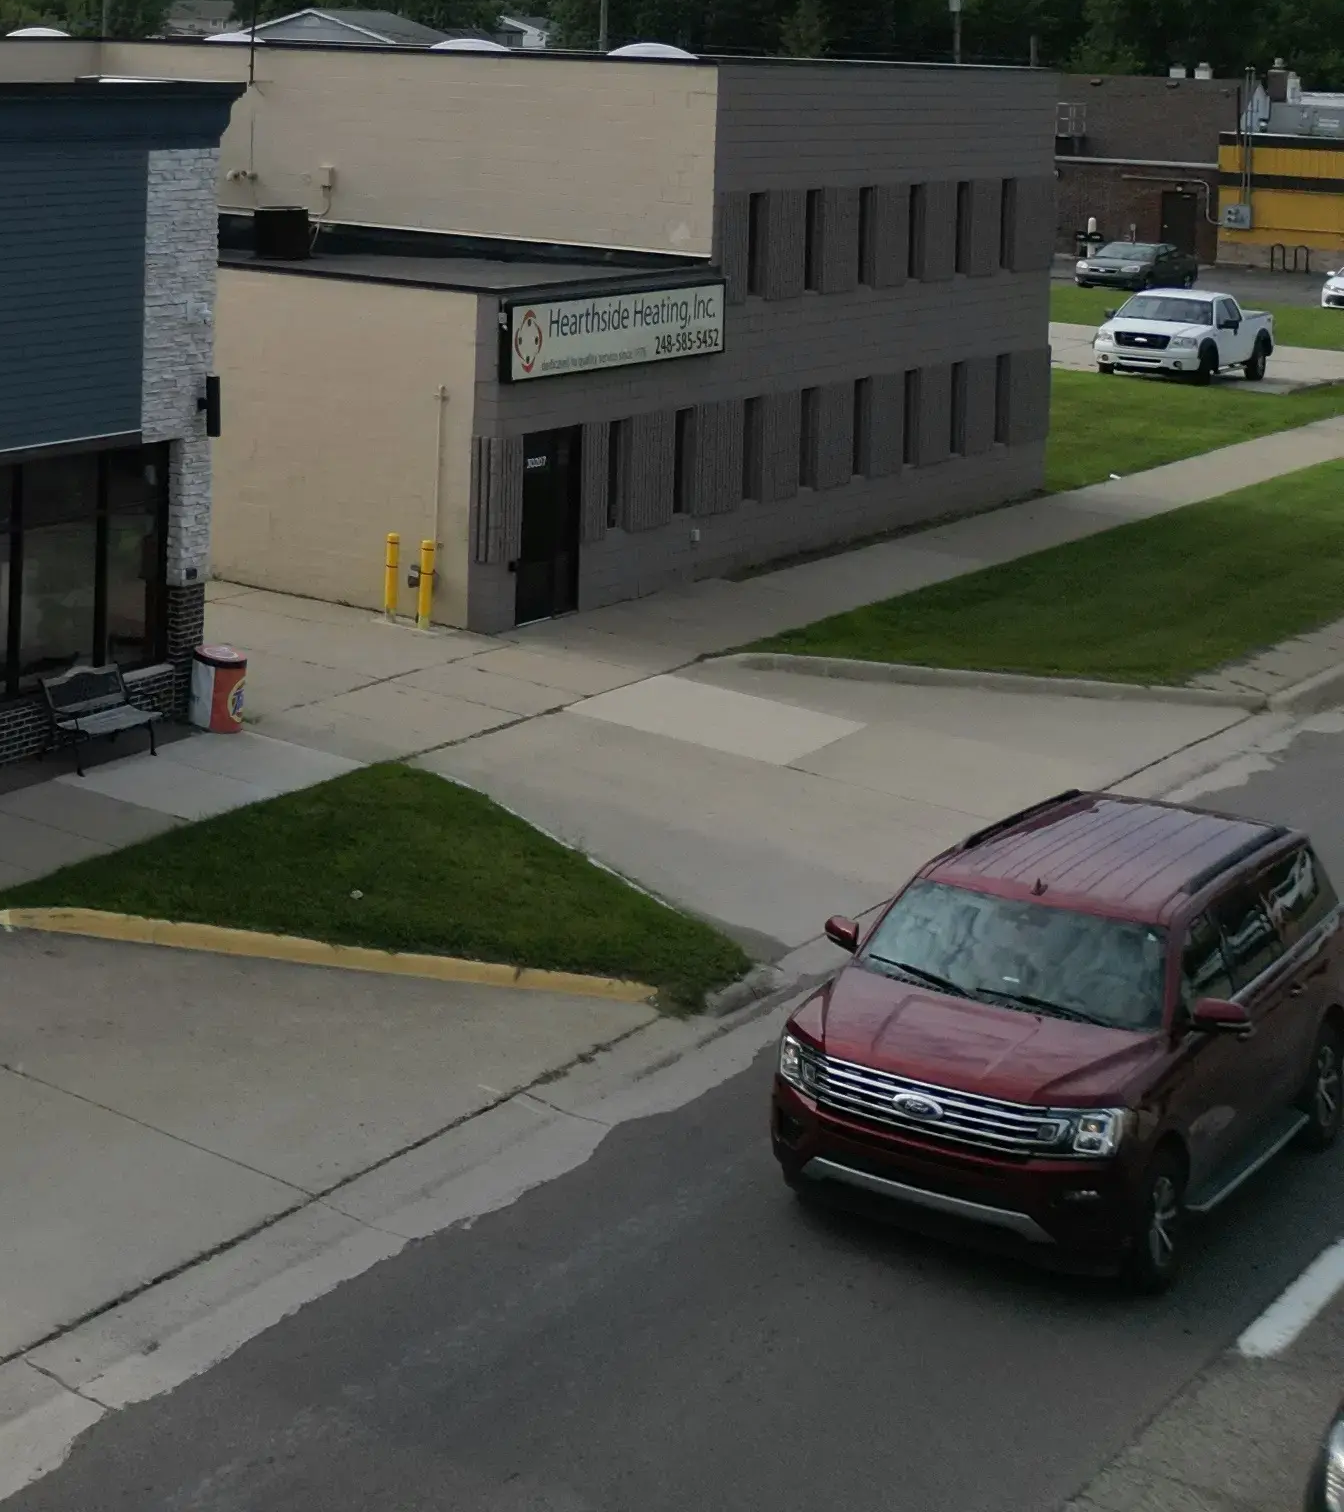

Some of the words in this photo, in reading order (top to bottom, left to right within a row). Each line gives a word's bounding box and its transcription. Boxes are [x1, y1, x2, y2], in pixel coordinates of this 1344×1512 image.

[548, 303, 629, 338] Hearthside
[633, 296, 691, 330] Heating,
[693, 293, 716, 320] Inc.
[655, 328, 719, 355] 248-585-5452
